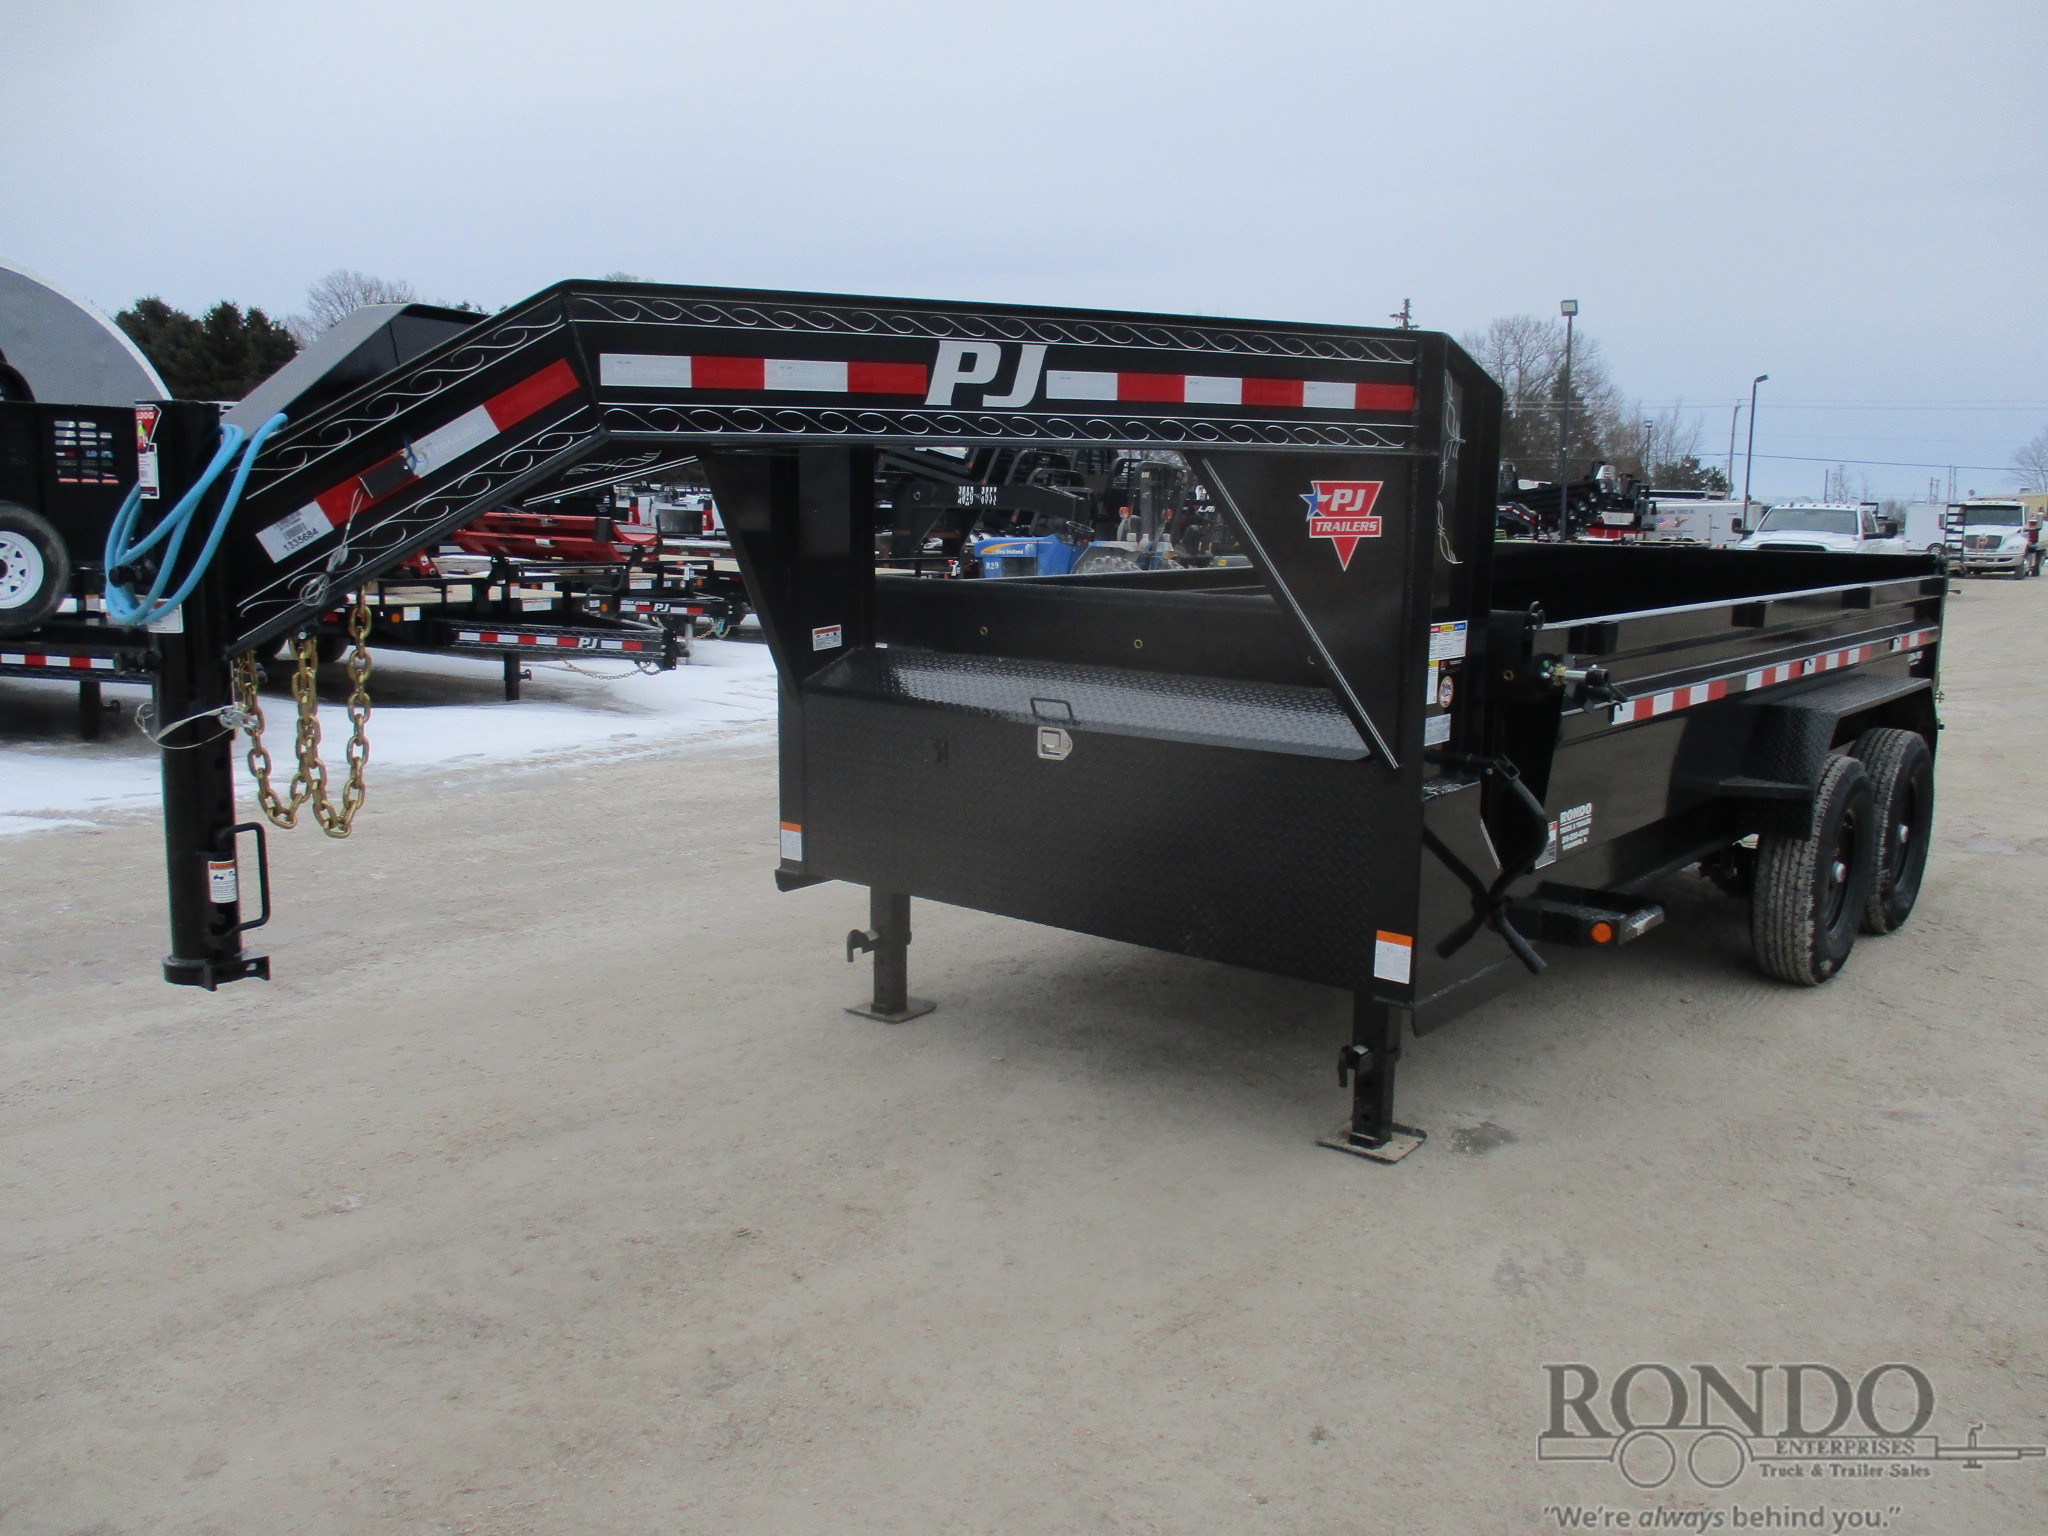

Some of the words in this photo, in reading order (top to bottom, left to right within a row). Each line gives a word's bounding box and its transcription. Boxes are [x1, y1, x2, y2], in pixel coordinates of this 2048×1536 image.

[924, 340, 1049, 408] PJ
[1329, 488, 1367, 512] PJ
[1315, 521, 1378, 532] TRAILERS
[282, 527, 319, 551] 1335684
[653, 603, 670, 612] PJ
[578, 637, 599, 649] PJ
[1560, 802, 1593, 824] RONDO
